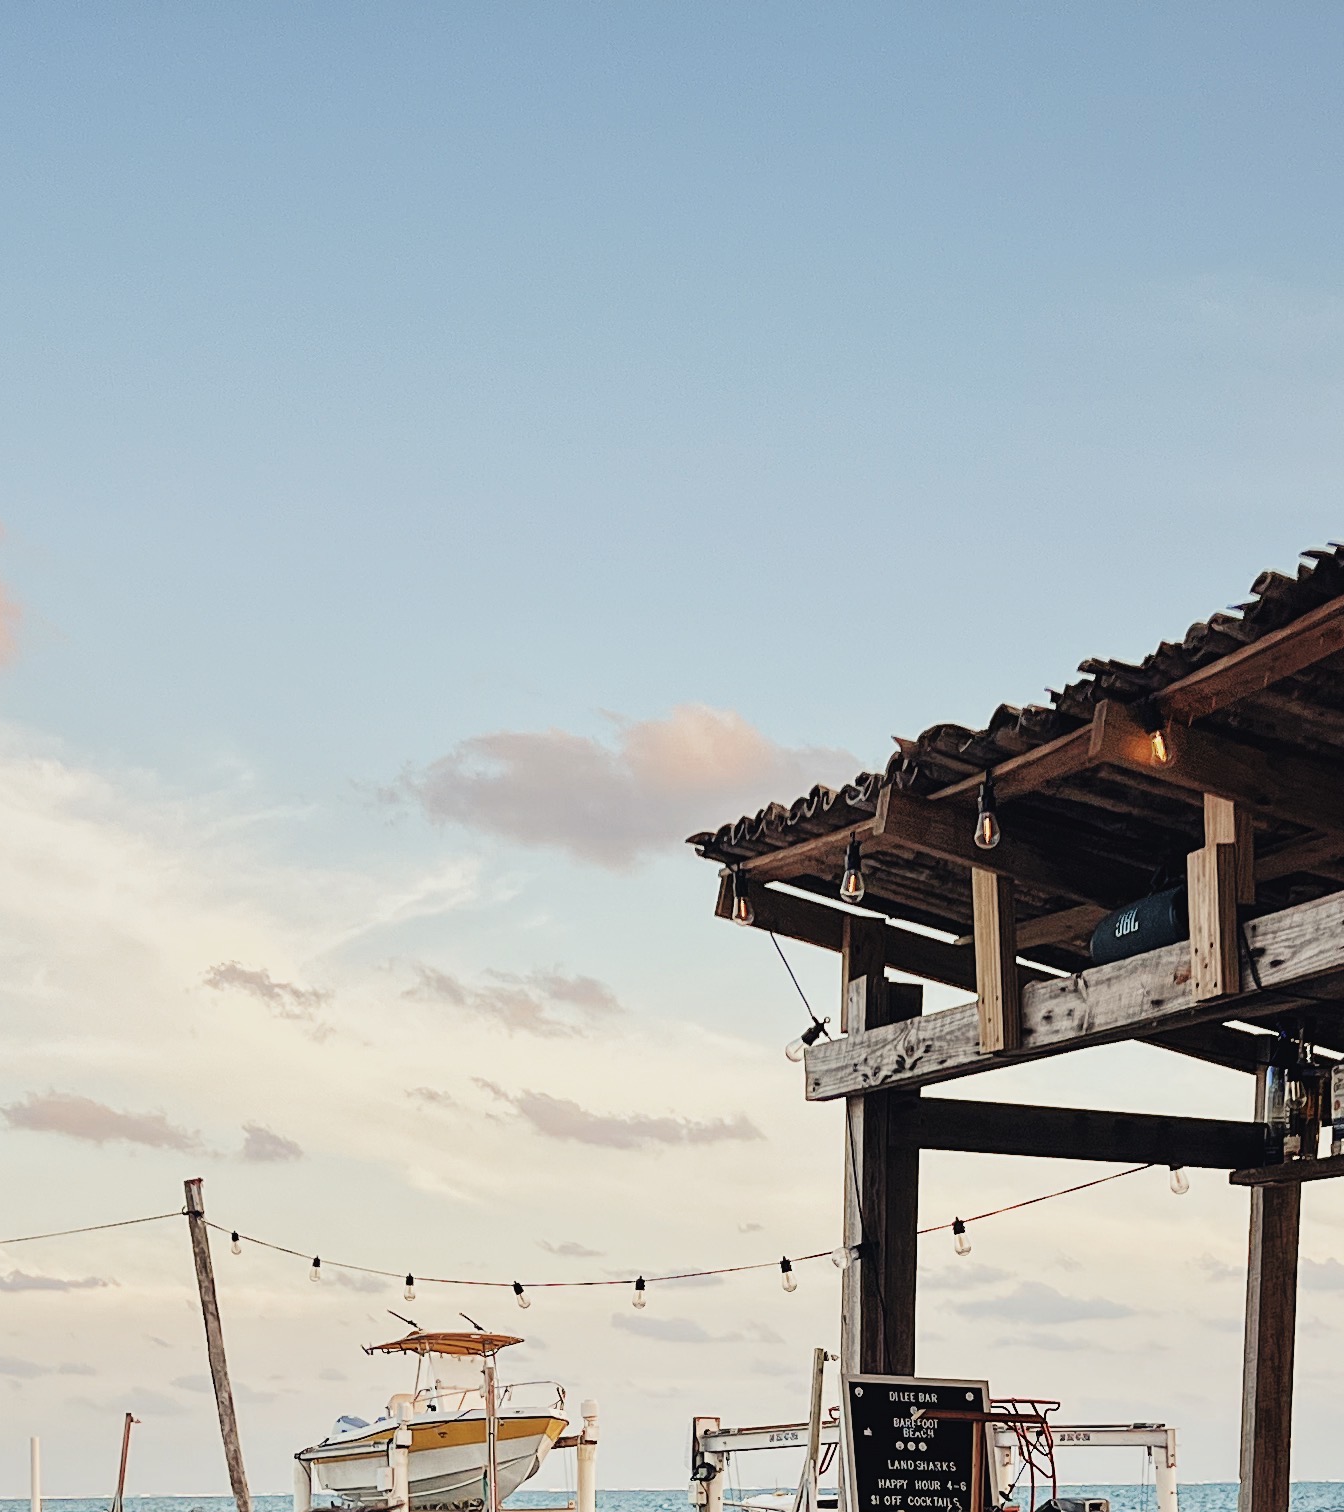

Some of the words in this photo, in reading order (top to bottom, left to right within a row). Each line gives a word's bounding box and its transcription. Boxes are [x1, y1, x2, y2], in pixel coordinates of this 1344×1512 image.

[1115, 908, 1139, 938] JBL
[918, 1393, 938, 1404] BAR
[893, 1418, 939, 1428] BAREFOOT
[903, 1428, 935, 1438] BEACH
[878, 1479, 908, 1490] HAPPY
[915, 1480, 941, 1491] HOUR
[947, 1481, 967, 1492] 4-6
[883, 1496, 902, 1506] OFF
[907, 1496, 960, 1508] COCKTAILS
